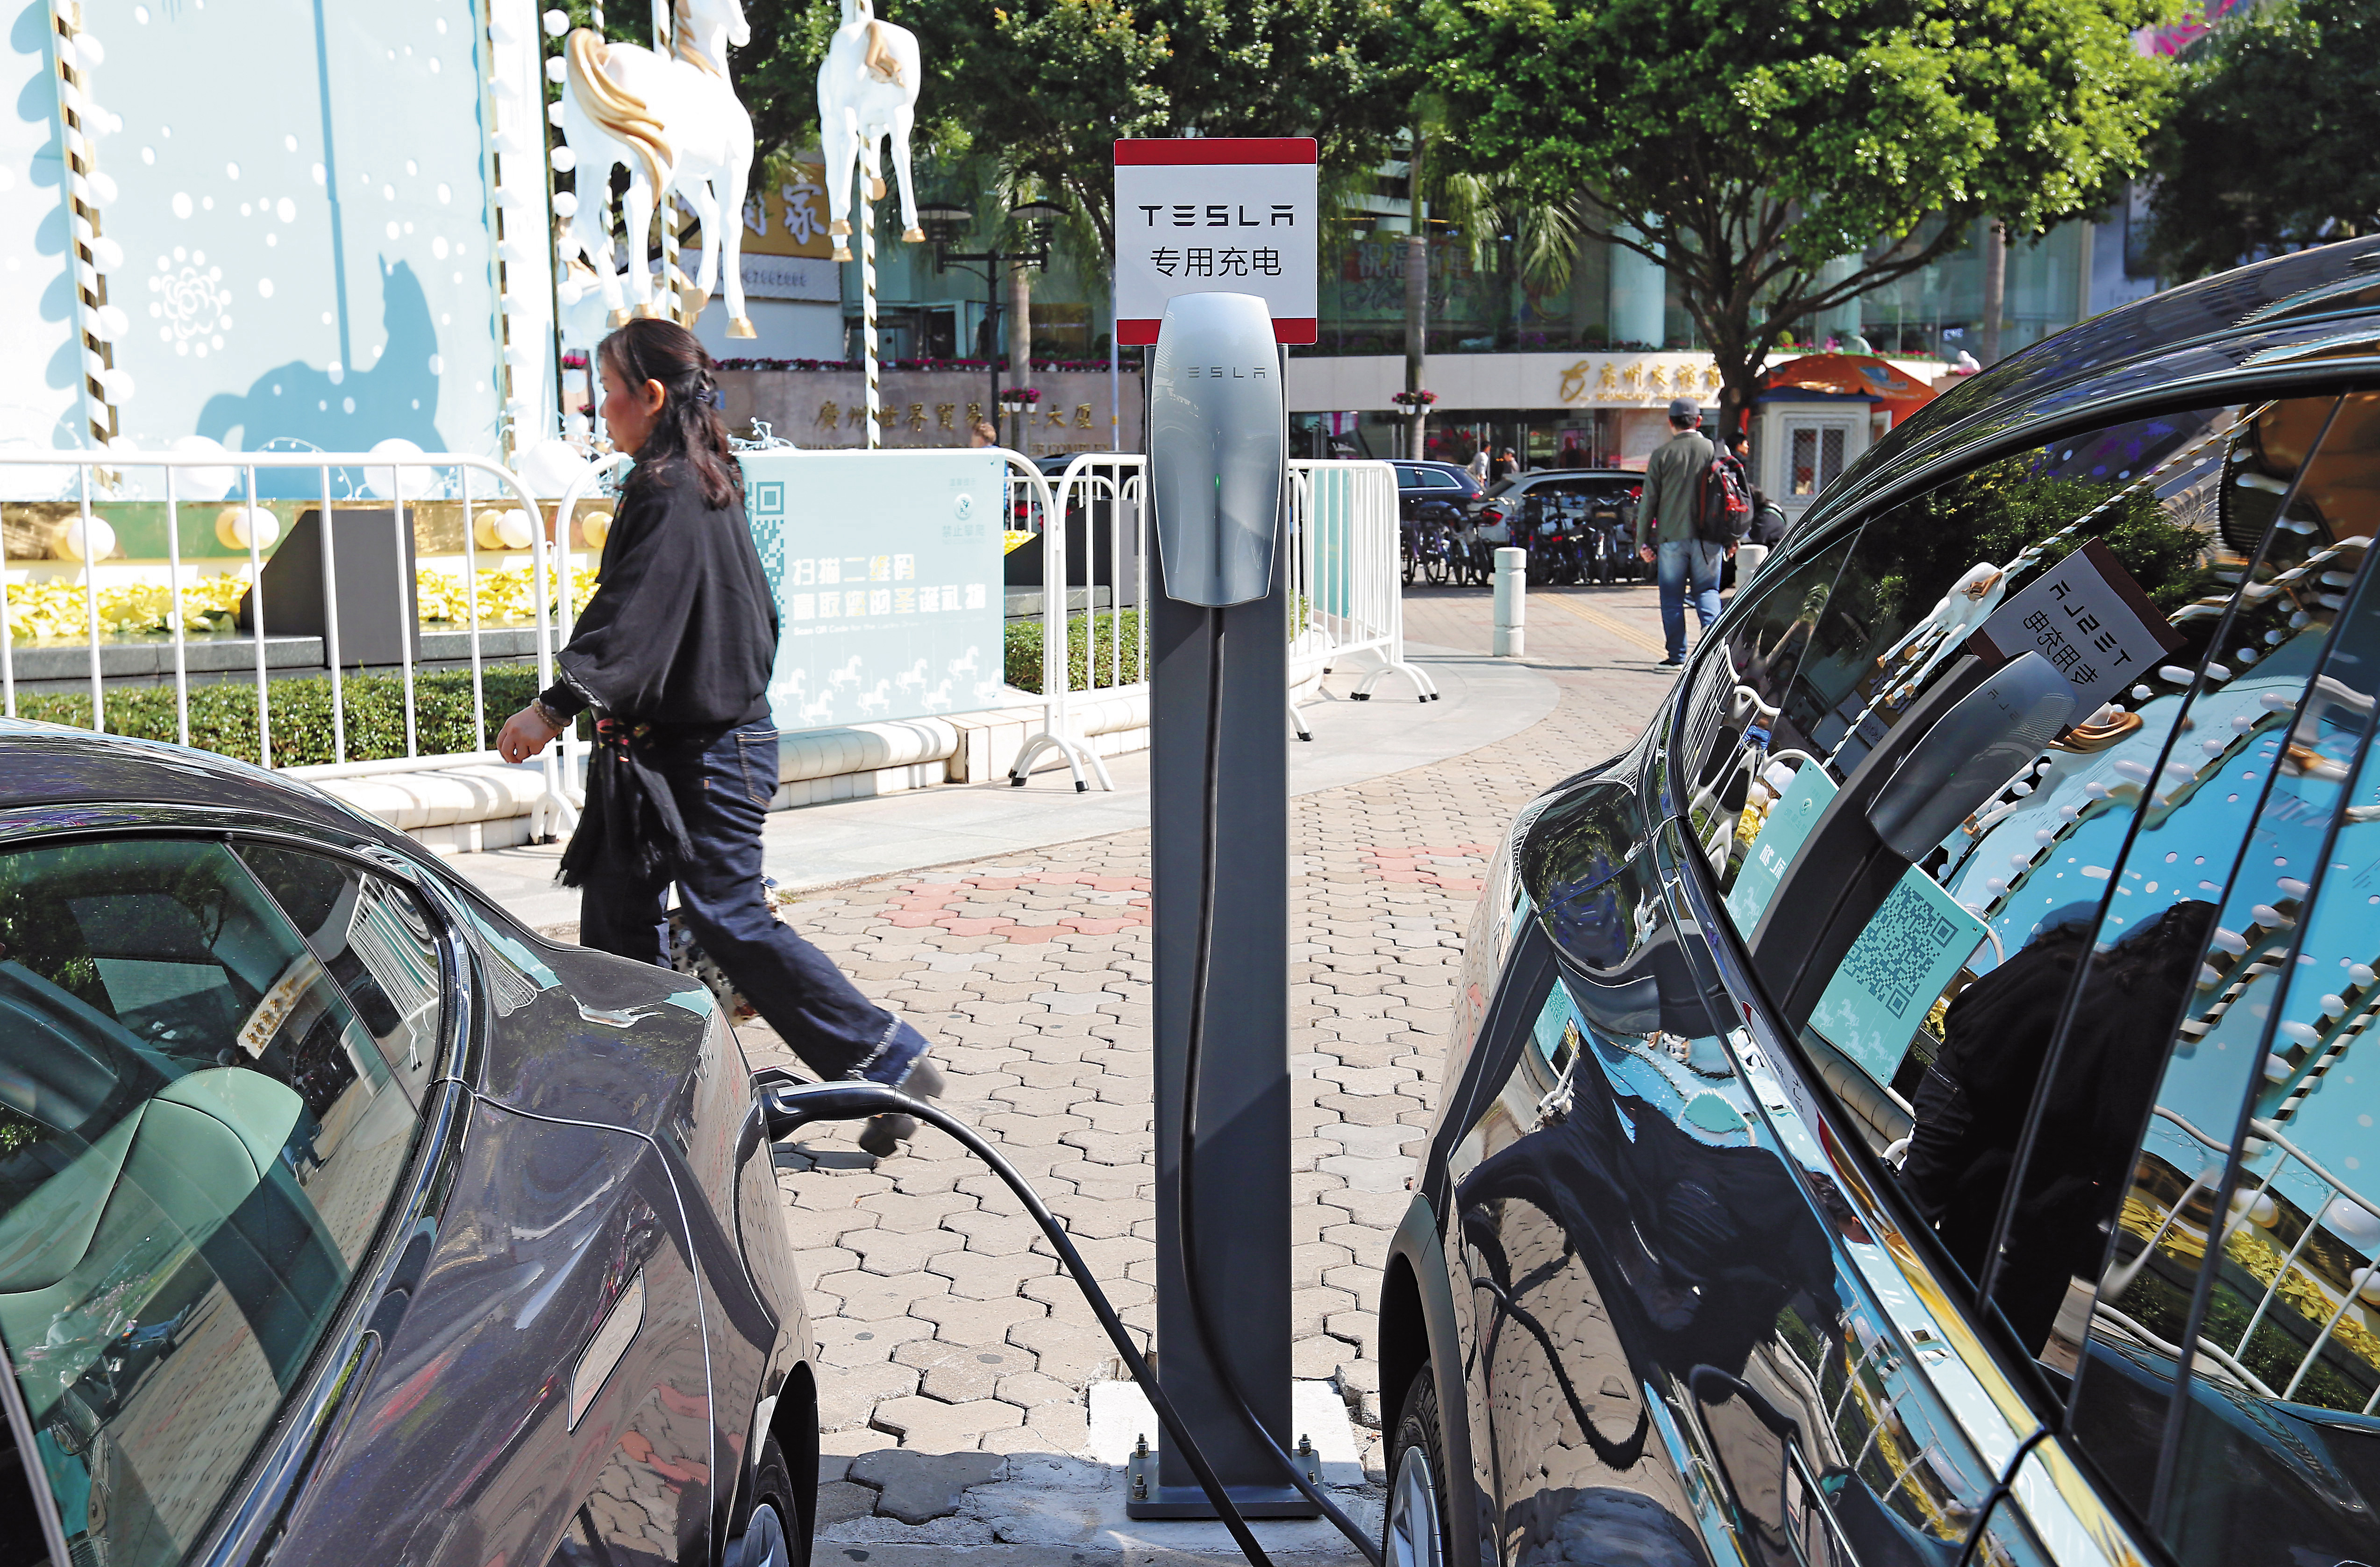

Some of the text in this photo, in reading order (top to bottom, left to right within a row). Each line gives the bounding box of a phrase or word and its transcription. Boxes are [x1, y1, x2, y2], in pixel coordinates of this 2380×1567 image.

[1138, 205, 1294, 227] TESLA
[1150, 246, 1282, 278] 专用充电
[792, 553, 915, 586] 扫描二维码
[793, 627, 813, 636] Scan
